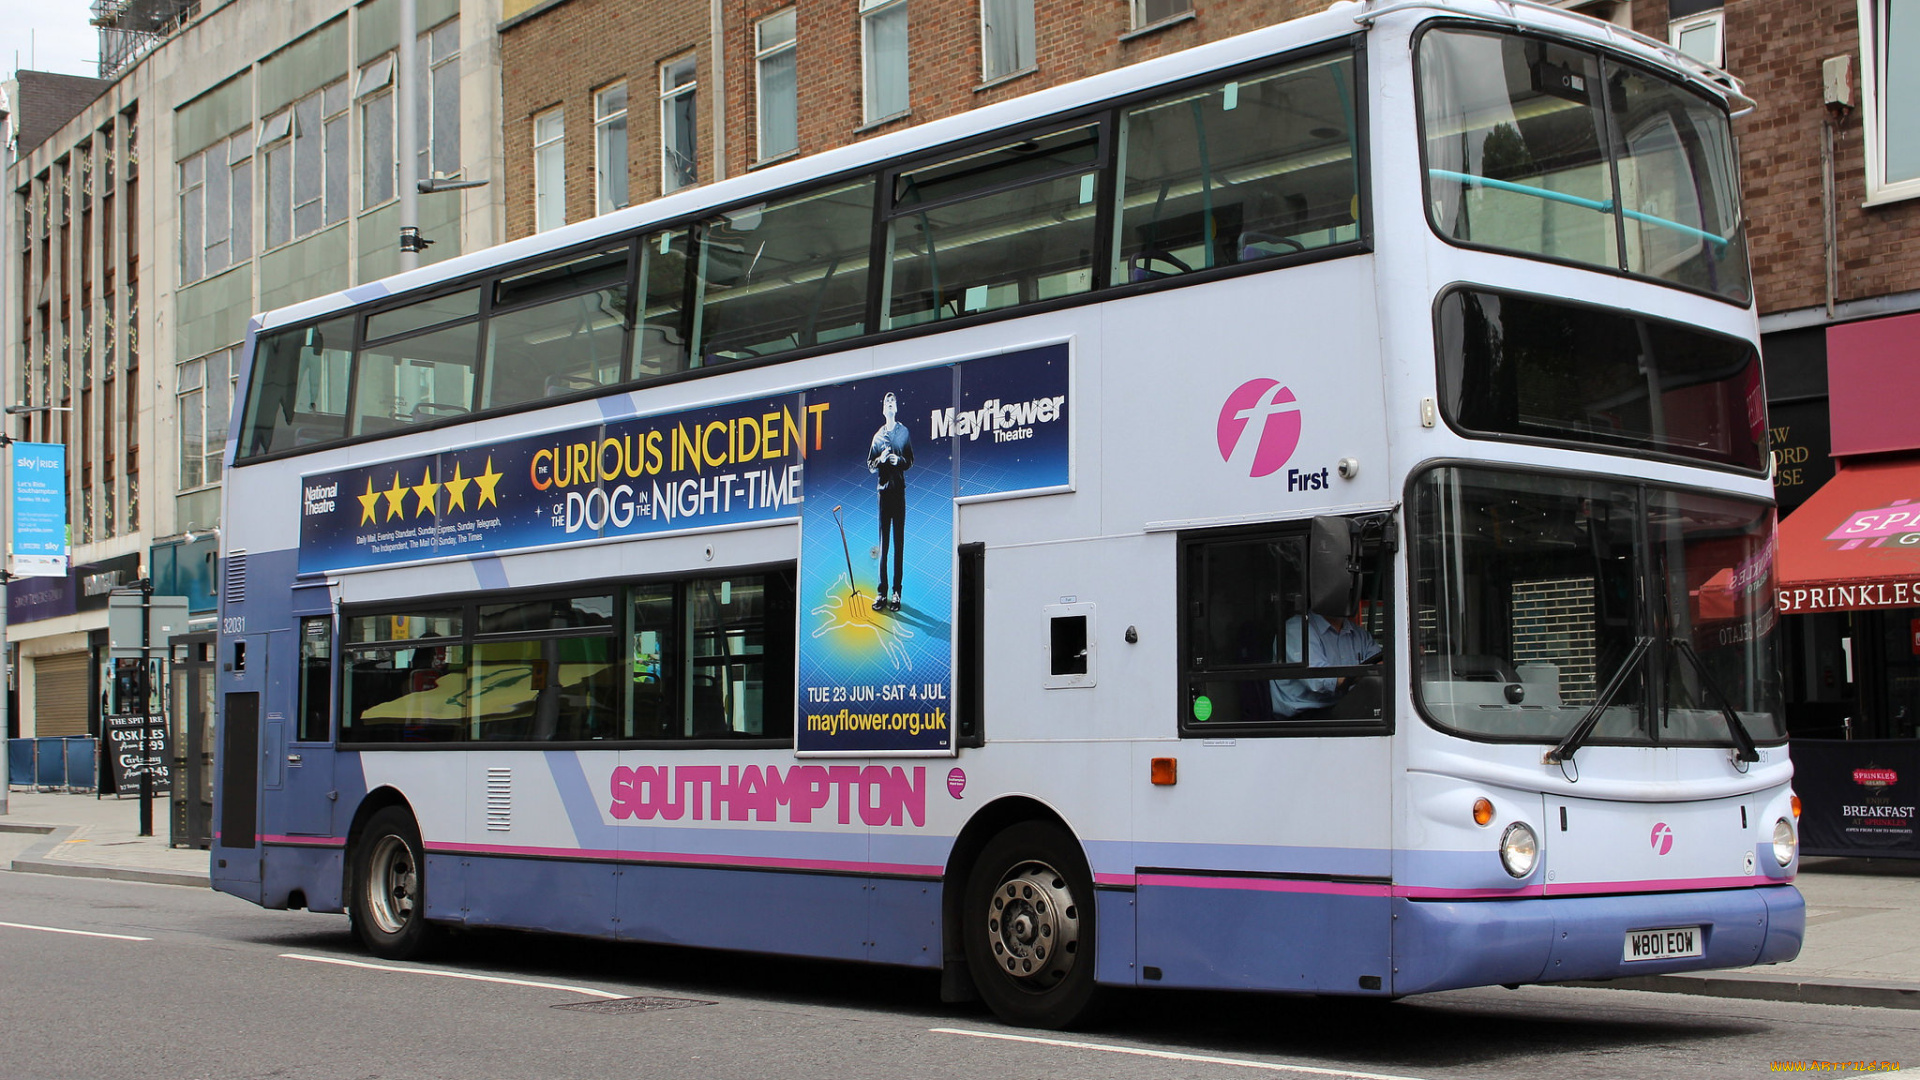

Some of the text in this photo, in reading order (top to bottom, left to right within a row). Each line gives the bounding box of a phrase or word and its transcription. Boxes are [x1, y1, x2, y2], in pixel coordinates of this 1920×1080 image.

[931, 395, 1065, 441] Mayflower
[993, 427, 1033, 443] Theatre
[530, 402, 830, 491] THE CURIOUS INCIDENT
[17, 457, 59, 470] sky RIDE
[1288, 467, 1329, 492] First
[17, 487, 58, 495] Southampton
[305, 481, 338, 501] National
[551, 463, 804, 534] OF THE DOG IN THE NIGHT-TIME
[304, 499, 336, 516] Theatre
[356, 534, 367, 546] Daily
[377, 531, 395, 542] Evening
[395, 527, 418, 540] Standard,
[418, 524, 437, 536] Sunday
[457, 521, 476, 532] Sunday
[476, 516, 502, 530] Telegraph,
[44, 541, 59, 552] sky
[371, 544, 381, 554] The
[380, 540, 409, 554] Independent,
[410, 538, 419, 549] The
[420, 537, 430, 547] Mail
[458, 533, 467, 544] The
[468, 532, 483, 542] Times
[1779, 582, 1920, 611] SPRINKLES
[223, 616, 245, 634] 32031
[807, 686, 830, 703] TUE
[832, 686, 847, 702] 23
[909, 685, 917, 700] 4
[920, 683, 946, 700] JUL
[127, 716, 163, 724] SPITIRE
[807, 707, 947, 736] mayflower.org.uk
[110, 730, 139, 741] CASK
[1853, 772, 1895, 780] SPRINKLES
[609, 765, 926, 828] SOUTHAMPTON
[1843, 805, 1916, 818] BREAKFAST
[1864, 818, 1907, 827] SPRINKLES
[1632, 931, 1693, 957] W801 EOW
